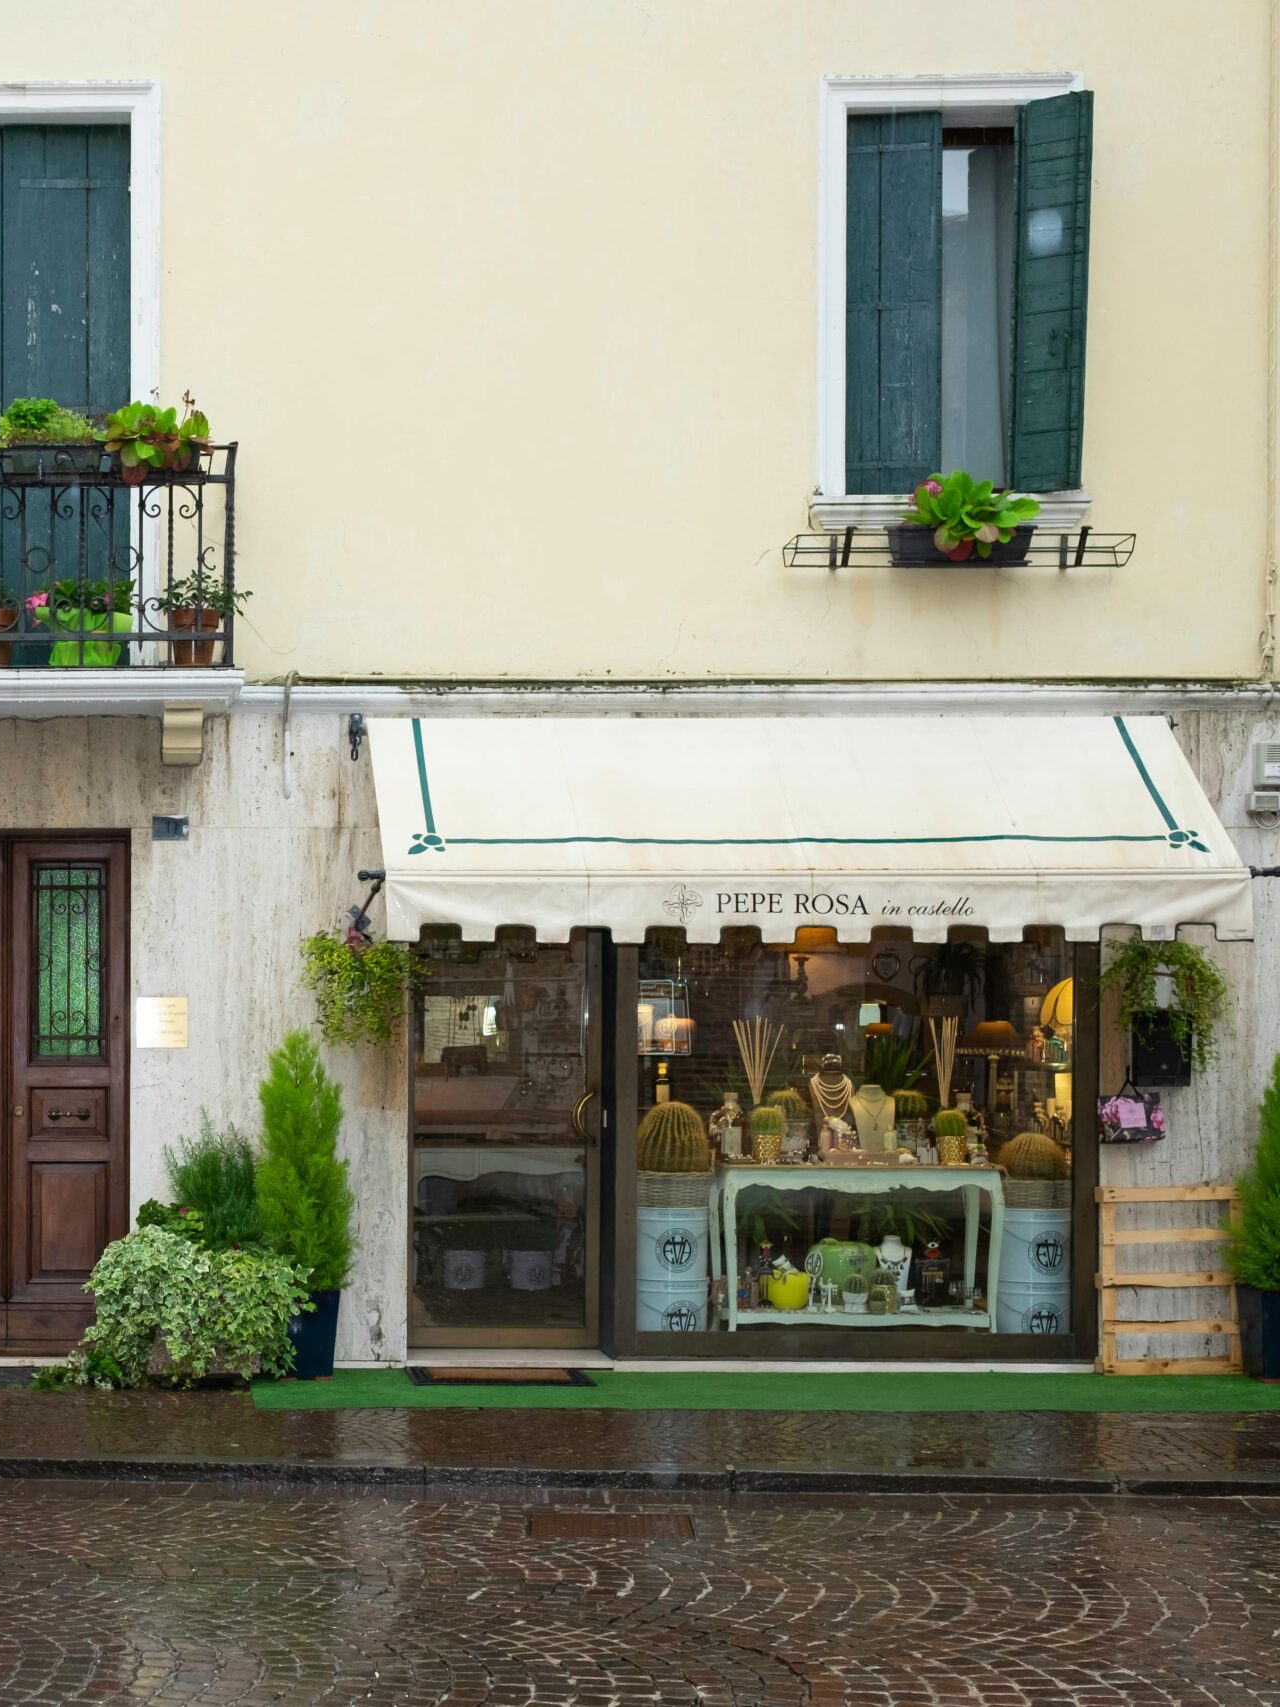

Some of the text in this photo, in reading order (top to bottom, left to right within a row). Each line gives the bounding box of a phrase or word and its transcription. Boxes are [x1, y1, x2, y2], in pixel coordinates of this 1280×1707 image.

[716, 893, 975, 916] PEPE ROSA in castello
